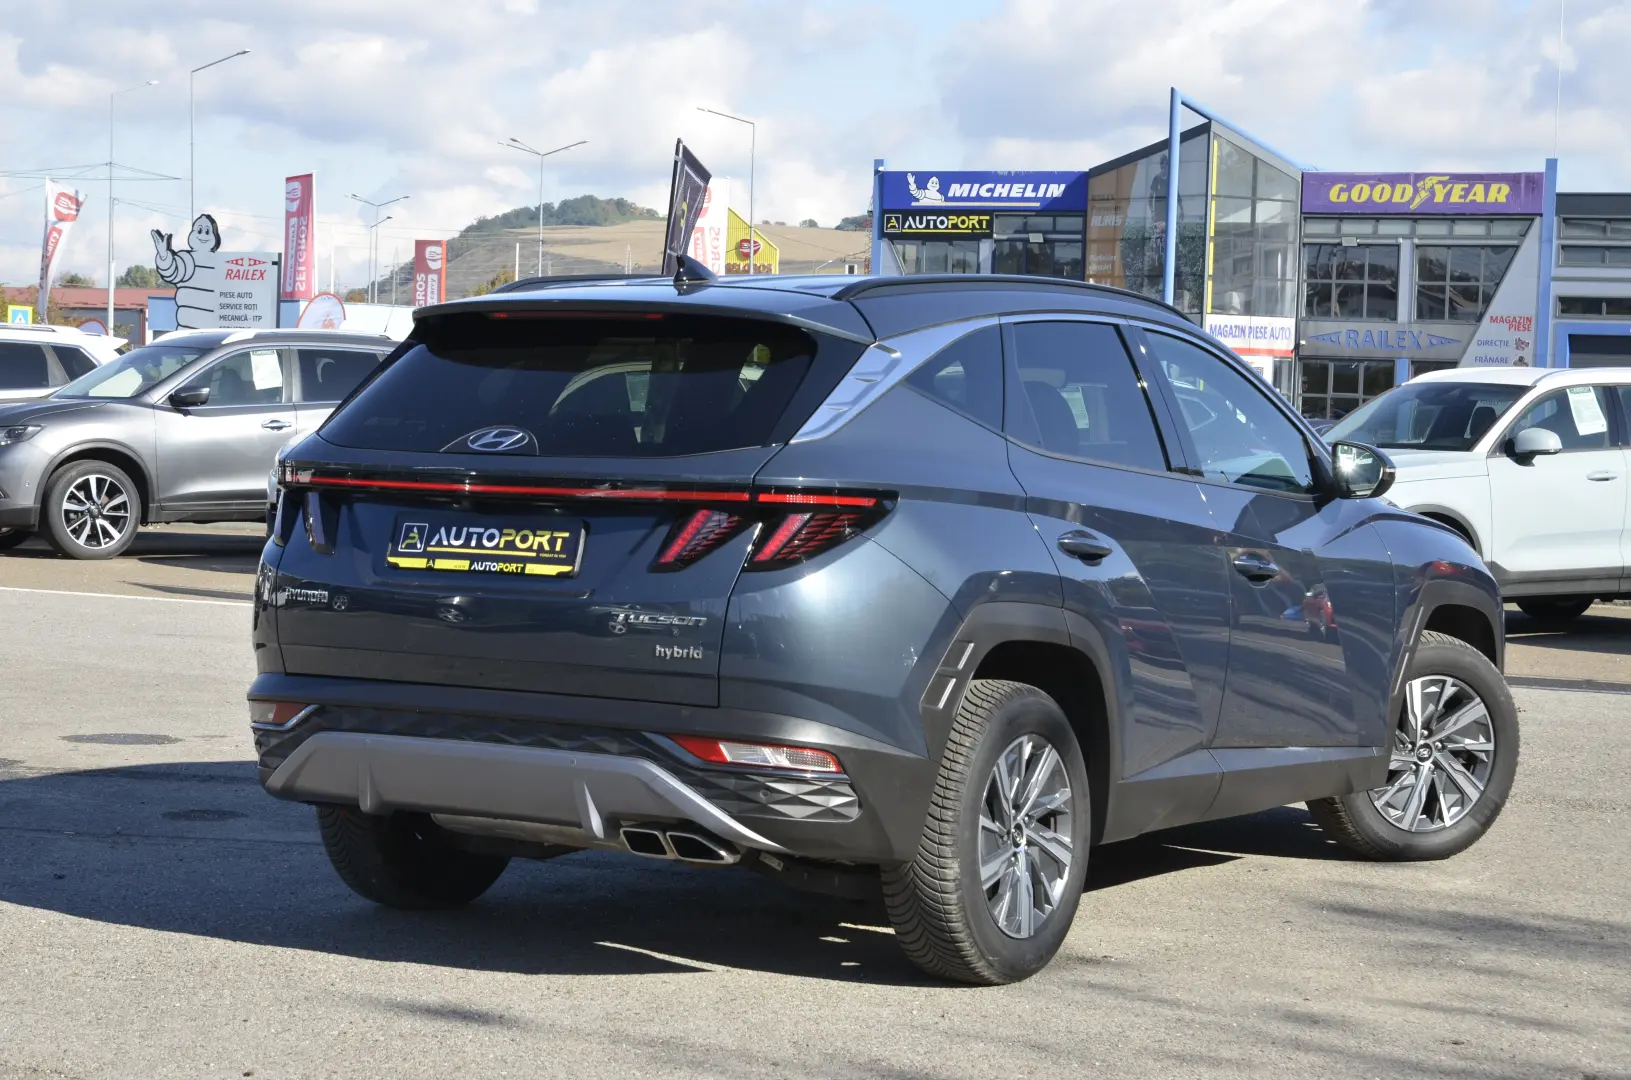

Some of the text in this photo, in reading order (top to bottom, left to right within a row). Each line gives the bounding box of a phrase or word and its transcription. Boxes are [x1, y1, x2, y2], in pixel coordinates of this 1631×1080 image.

[948, 183, 1066, 198] MICHELIN
[904, 215, 990, 229] AUTOPORT
[225, 269, 267, 281] RAILEX
[415, 273, 426, 307] GROS
[1490, 316, 1532, 324] MAGAZIN
[1209, 324, 1291, 340] MAGAZIN PIESE AUTO
[1508, 324, 1532, 332] PIESE
[1346, 329, 1424, 351] RAILEX
[429, 526, 570, 552] AUTOPORT
[470, 561, 524, 573] AUTOPORT
[655, 644, 704, 660] hybrid
